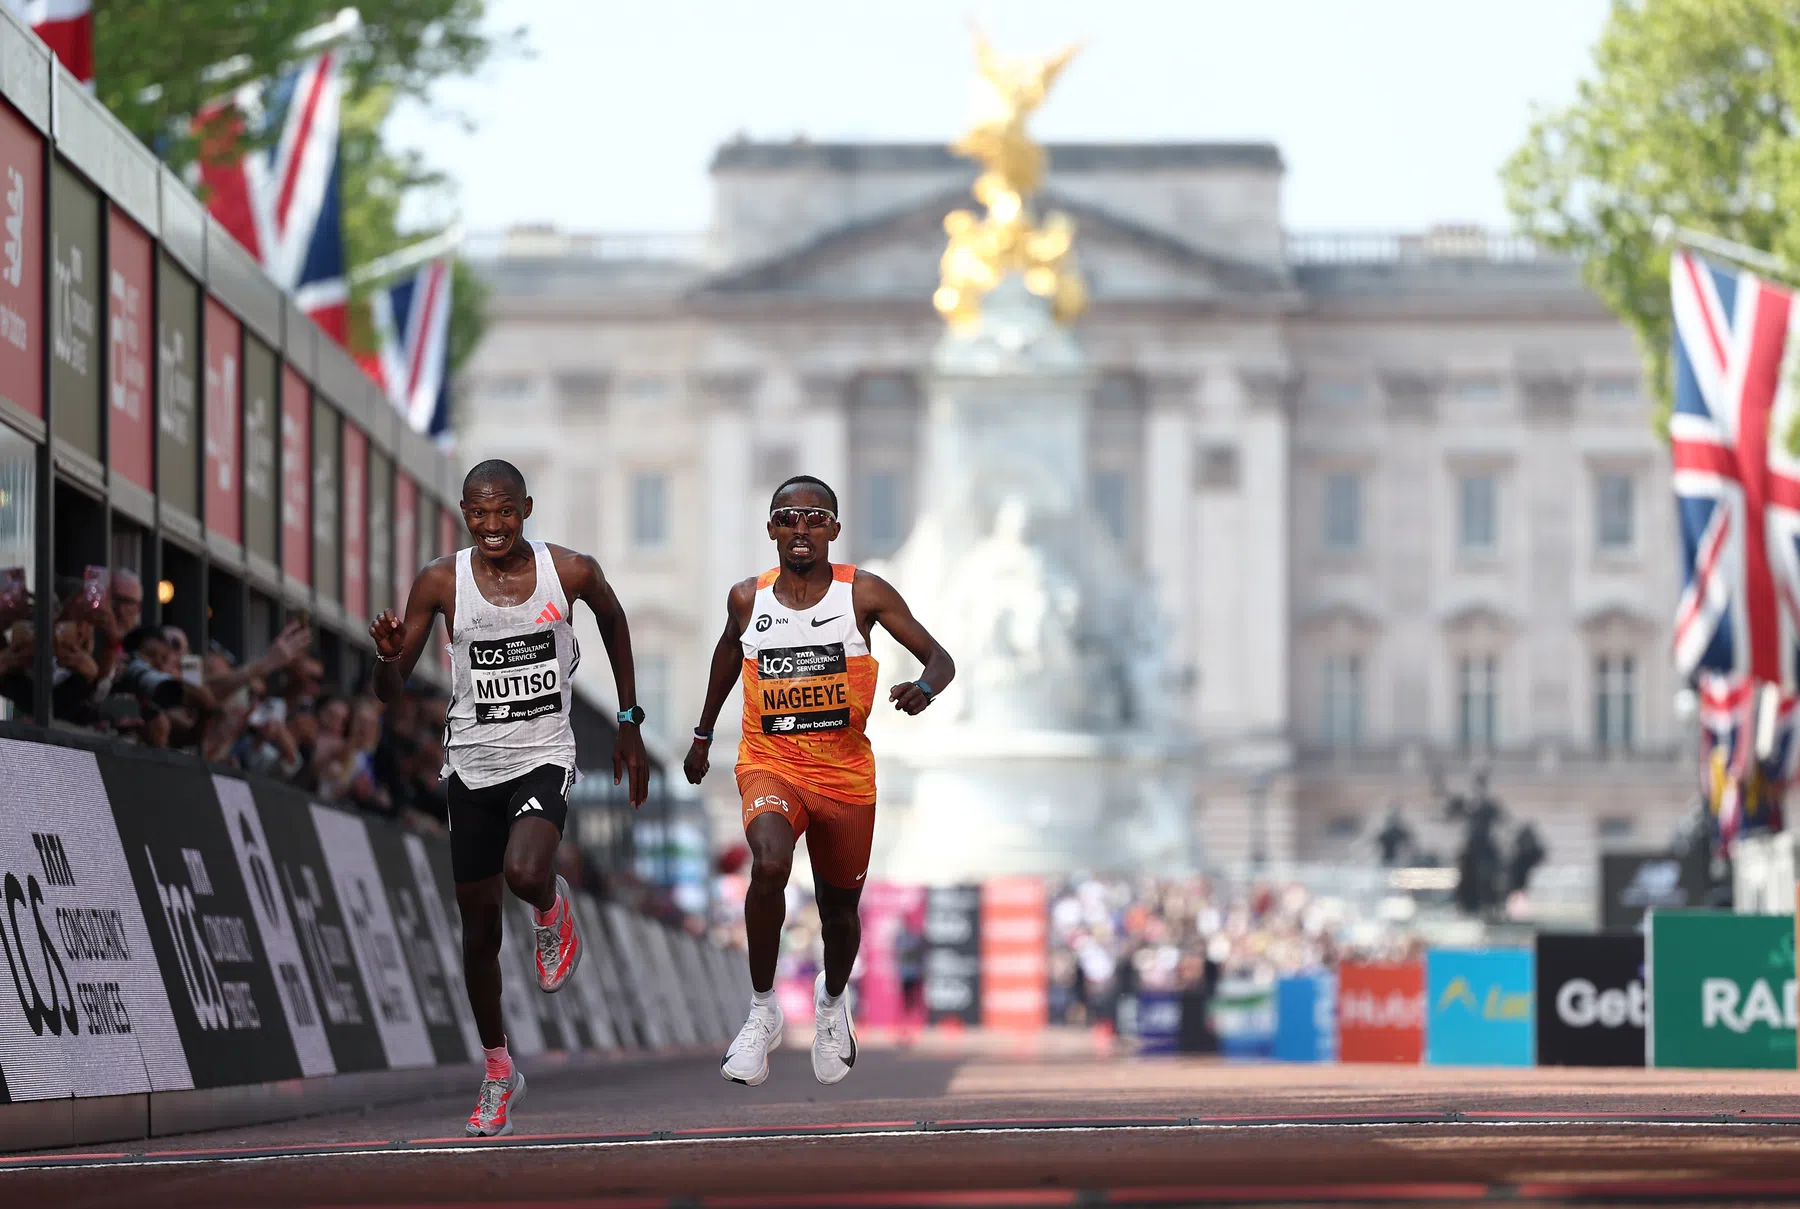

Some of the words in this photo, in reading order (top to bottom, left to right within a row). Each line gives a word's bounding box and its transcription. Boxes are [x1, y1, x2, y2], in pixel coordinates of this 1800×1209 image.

[506, 641, 526, 649] TATA
[506, 642, 550, 656] CONSULTANCY
[474, 647, 504, 665] tcs
[507, 652, 537, 663] SERVICES
[763, 655, 794, 674] tcs
[796, 655, 840, 666] CONSULTANCY
[796, 664, 826, 673] SERVICES
[476, 670, 557, 699] MUTISO
[763, 683, 847, 711] NAGEEYE
[511, 710, 527, 718] new
[527, 703, 555, 717] balance
[796, 722, 812, 730] new
[813, 719, 843, 729] balance
[32, 832, 76, 887] TATA
[56, 906, 132, 961] CONSULTANCY
[77, 981, 132, 1036] SERVICES
[1556, 977, 1646, 1028] Get
